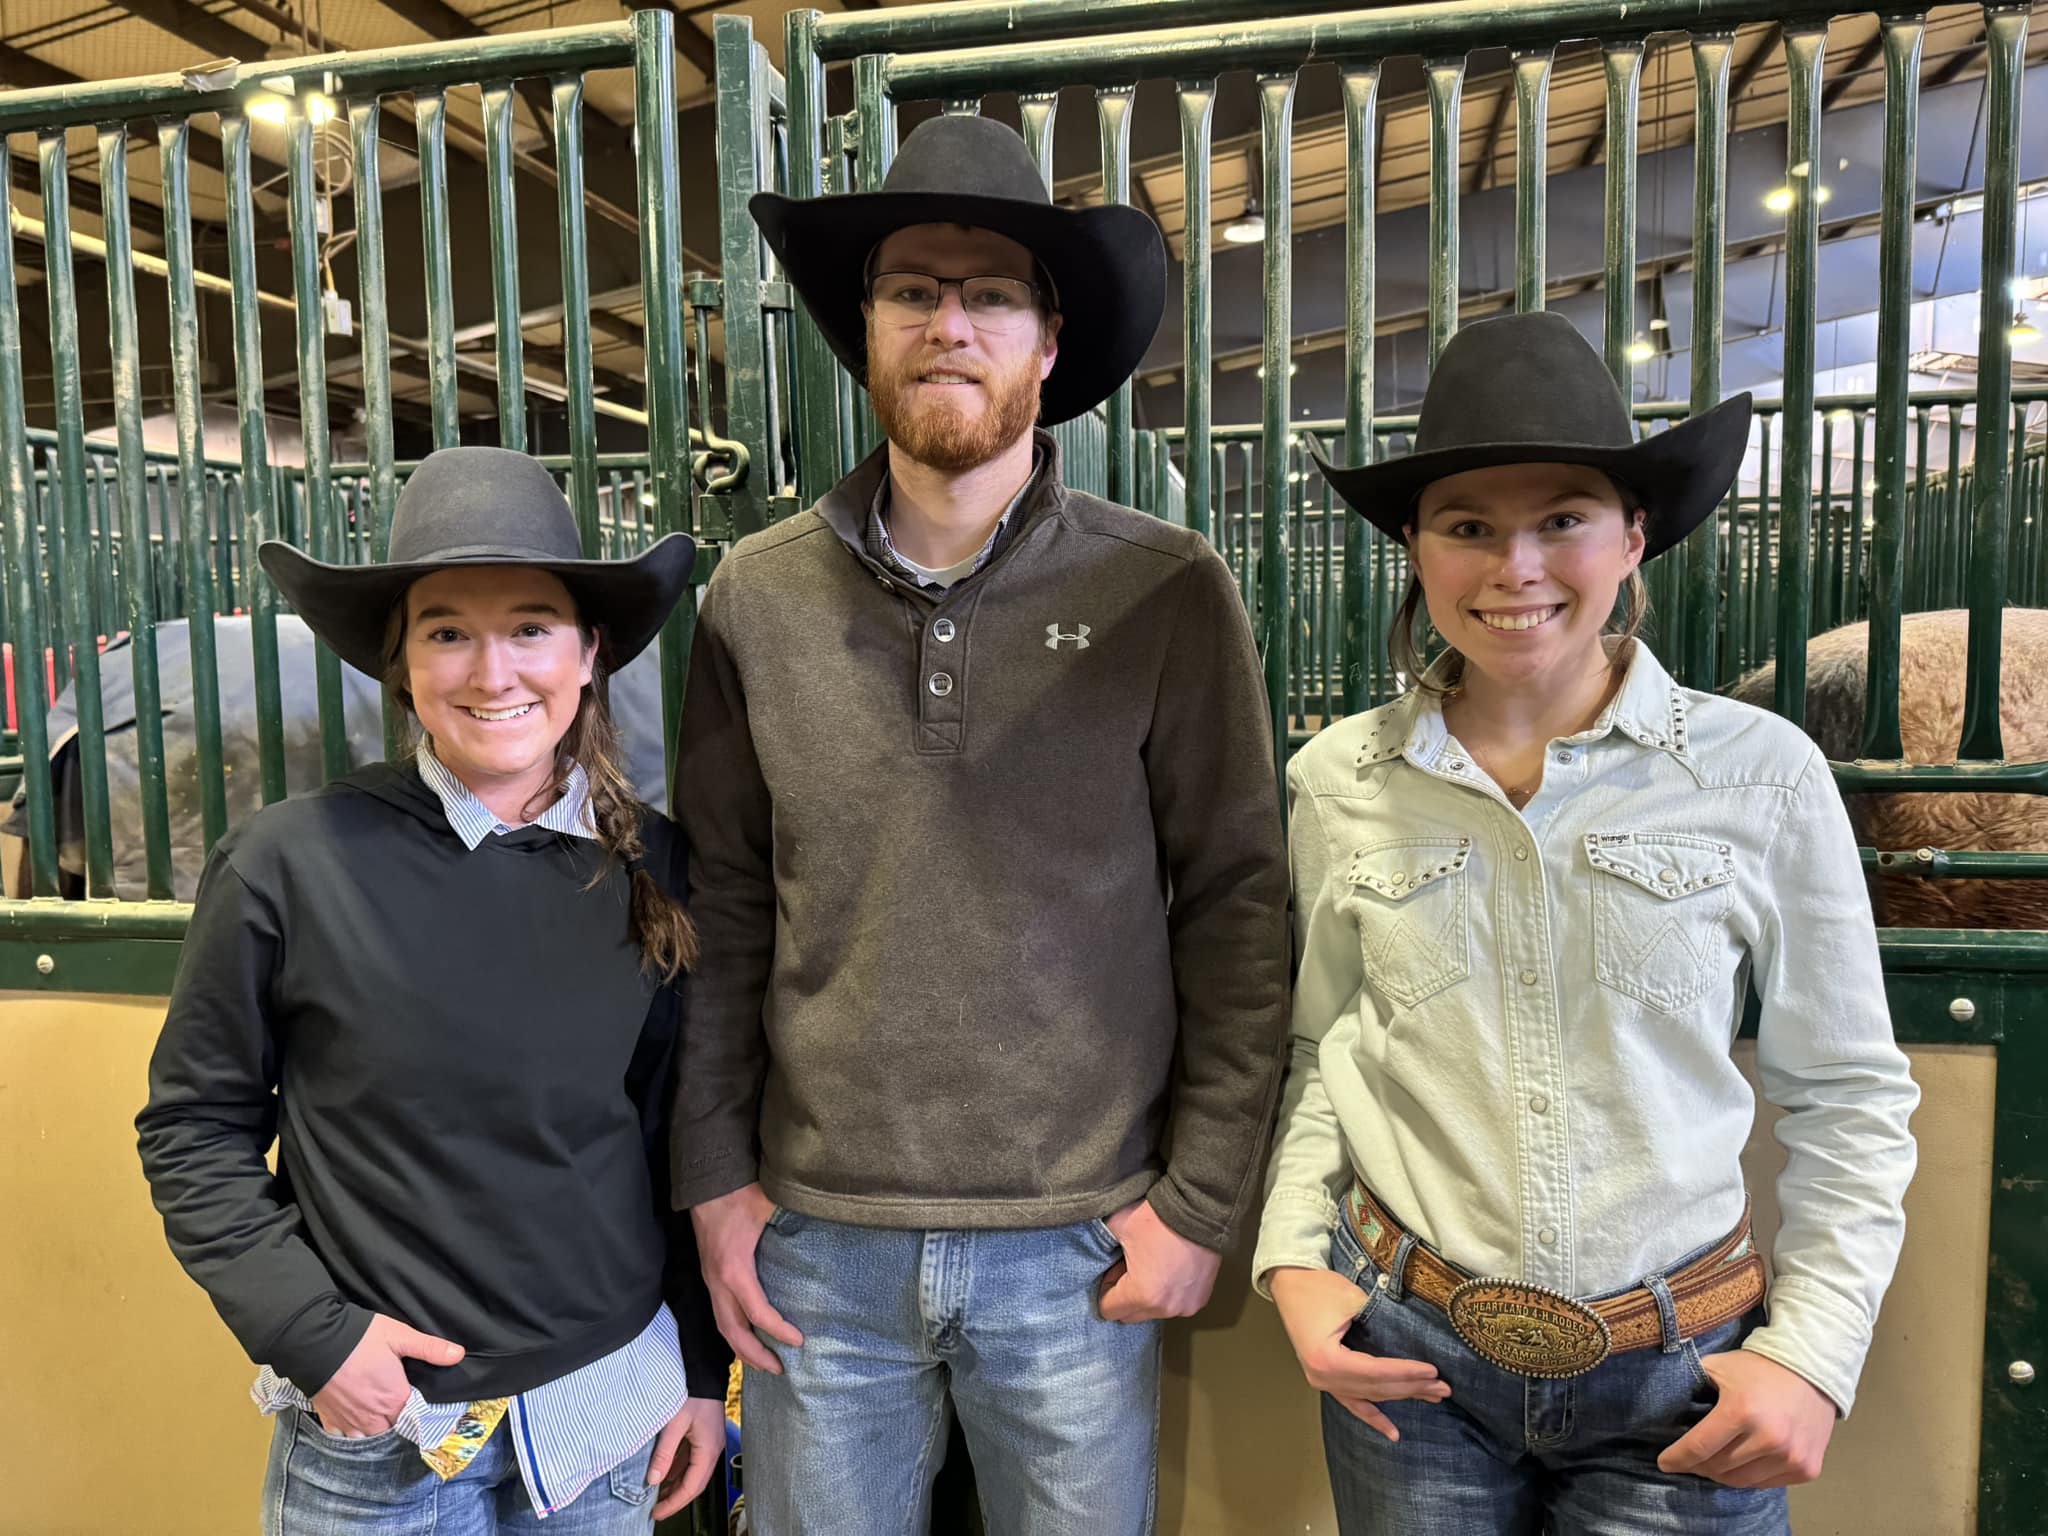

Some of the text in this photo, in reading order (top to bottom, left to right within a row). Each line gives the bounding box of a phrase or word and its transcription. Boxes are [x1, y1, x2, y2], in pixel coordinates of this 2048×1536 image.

[1601, 834, 1630, 844] Wrangler
[1473, 1302, 1585, 1333] HEARTLAND 4-H RODEO
[1483, 1324, 1496, 1336] 20
[1497, 1341, 1557, 1360] CHAMPION
[1559, 1340, 1572, 1350] 20
